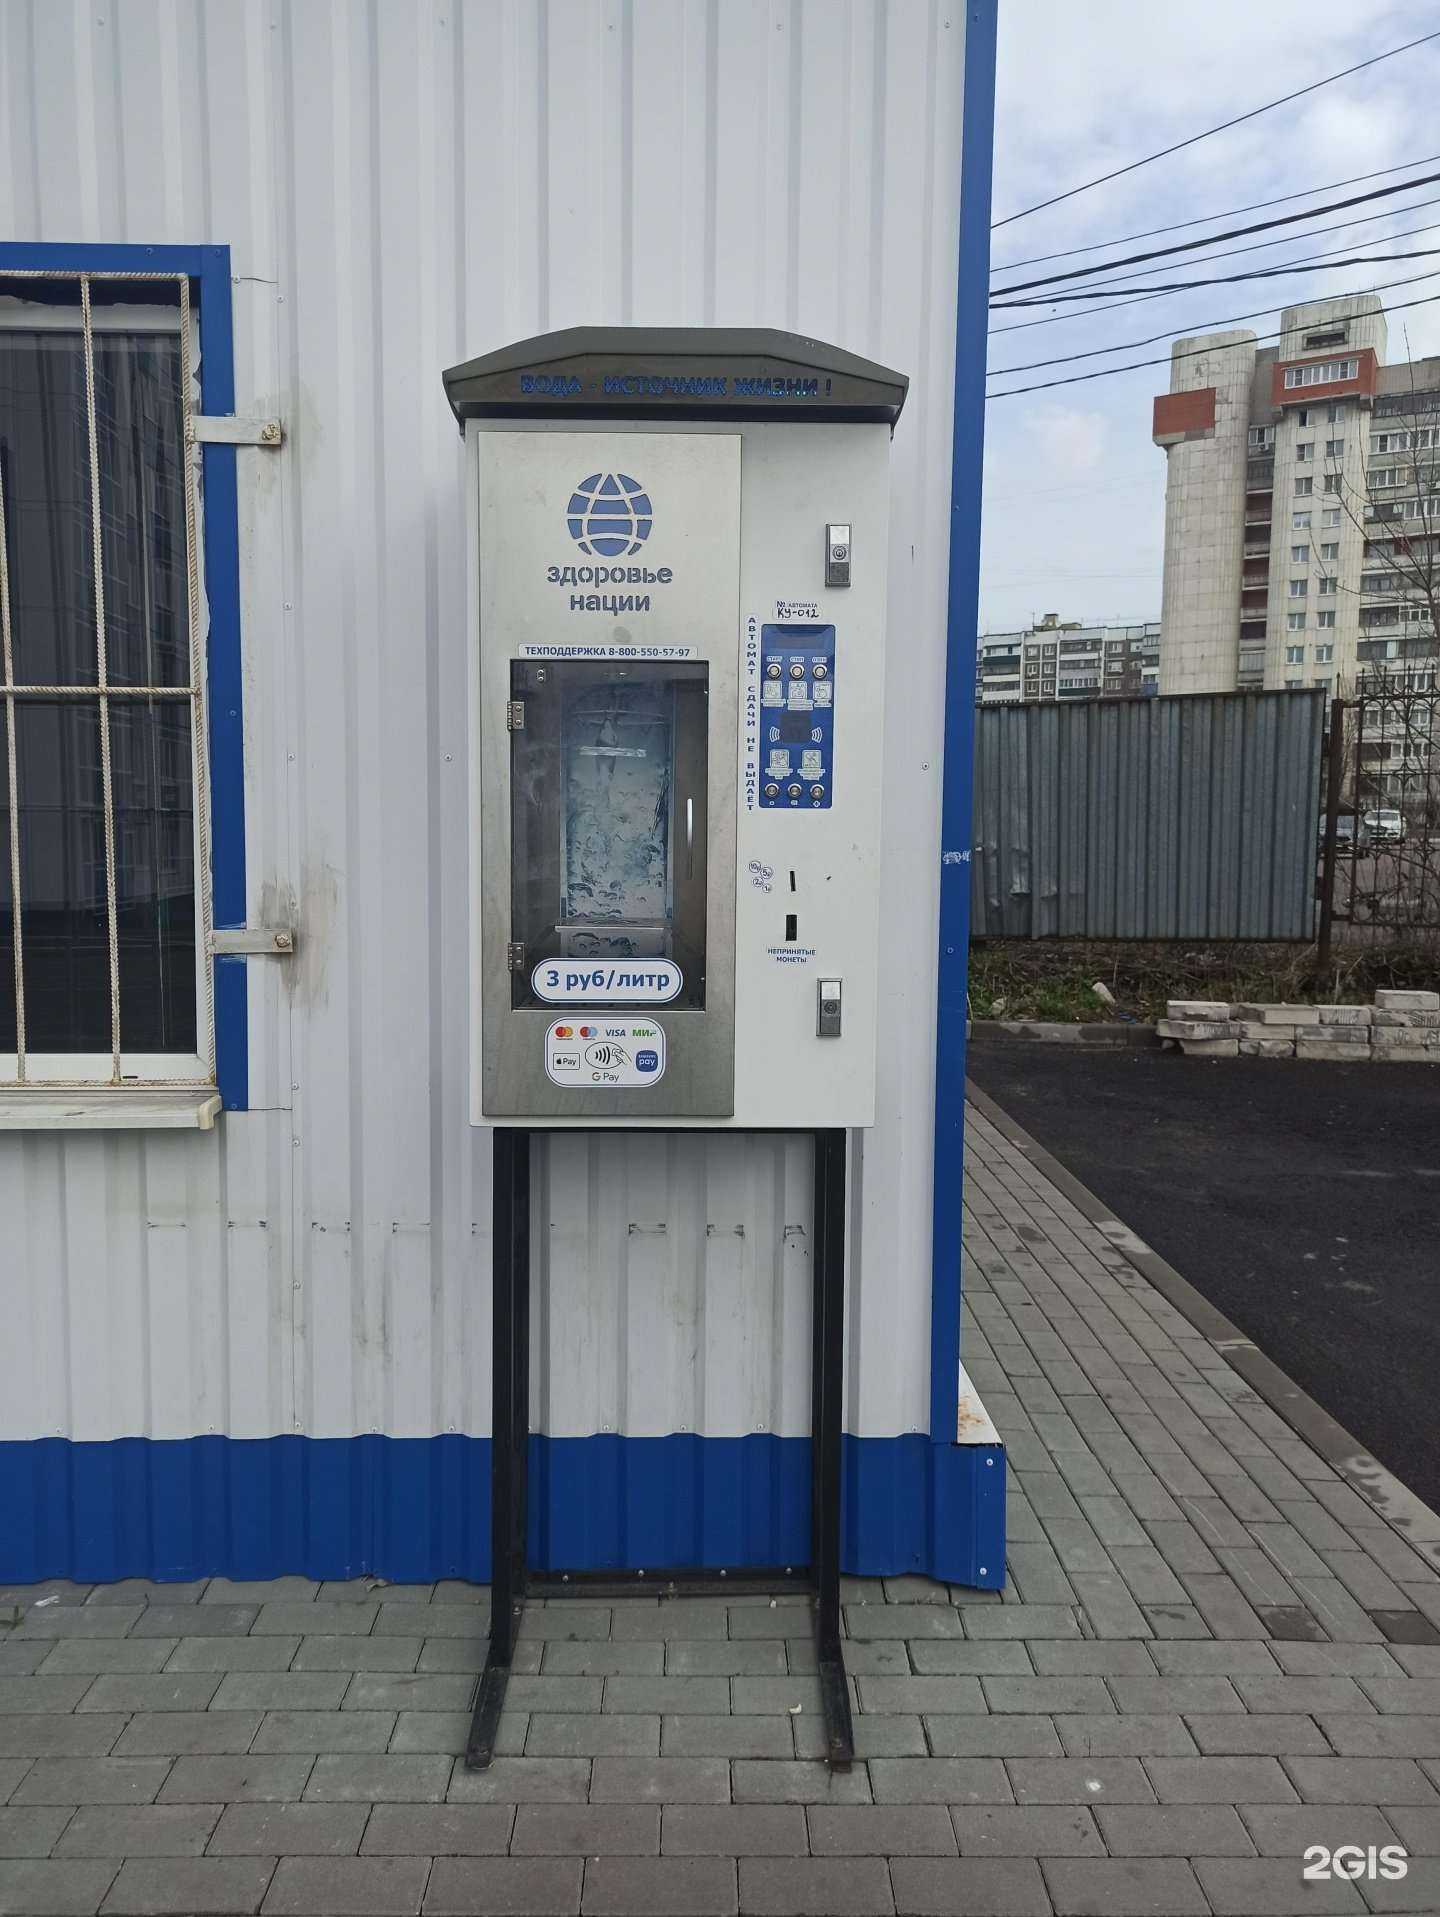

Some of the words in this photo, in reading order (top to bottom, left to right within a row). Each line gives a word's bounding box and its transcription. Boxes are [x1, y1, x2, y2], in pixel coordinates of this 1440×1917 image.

[521, 375, 582, 396] ВОДА
[603, 375, 726, 396] ИСТОЧНИК
[733, 376, 818, 396] ЖИЗНИ
[547, 566, 673, 588] здоровье
[570, 595, 650, 616] нации
[525, 646, 606, 657] ТЕХПОДДЕРЖКА
[608, 647, 691, 657] 8-800-550-57-97
[747, 617, 757, 675] АВТОМАТ
[746, 686, 756, 727] СДАЧИ
[746, 737, 756, 752] НЕ
[745, 762, 756, 811] ВЫДАЕТ
[767, 948, 816, 956] НЕПРИНЯТЫЕ
[546, 970, 560, 987] 3
[566, 970, 670, 991] руб/литр
[605, 1029, 626, 1037] VISA
[562, 1058, 577, 1066] Pay
[639, 1058, 656, 1066] pay
[603, 1072, 620, 1083] Pay
